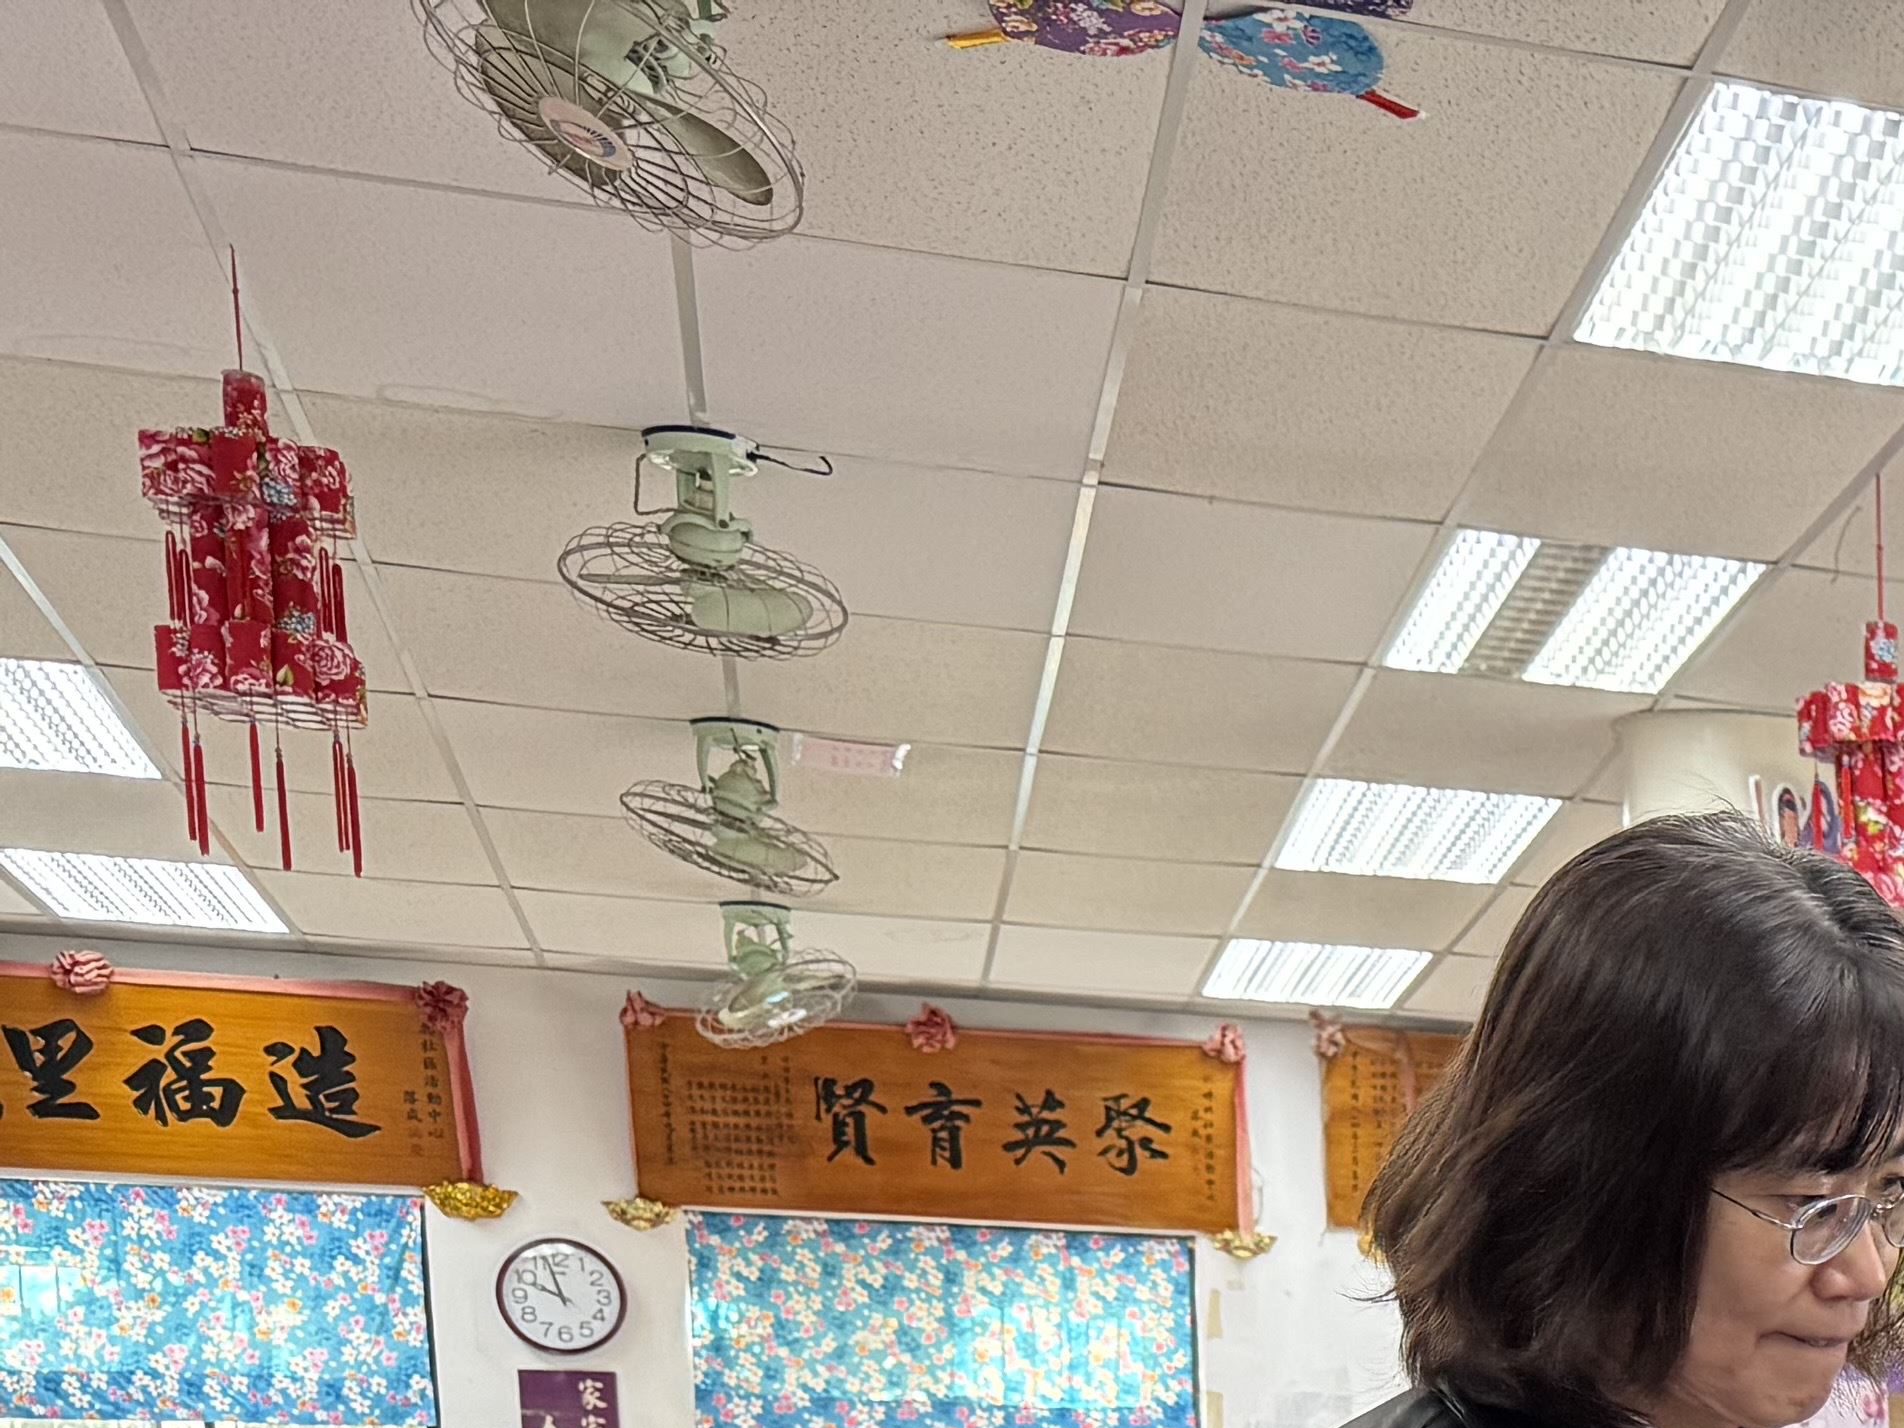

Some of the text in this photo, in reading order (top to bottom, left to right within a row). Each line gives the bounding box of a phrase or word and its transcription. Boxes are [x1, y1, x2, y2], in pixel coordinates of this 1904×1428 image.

[421, 1024, 444, 1139] 社區活動中心
[552, 1253, 569, 1268] 12
[578, 1257, 586, 1272] 1
[515, 1268, 537, 1285] 10
[589, 1270, 605, 1287] 2
[511, 1287, 528, 1304] 9
[597, 1289, 612, 1306] 3
[521, 1306, 537, 1323] 8
[592, 1308, 606, 1322] 4
[539, 1321, 554, 1338] 7
[558, 1326, 574, 1343] 6
[579, 1321, 594, 1338] 5
